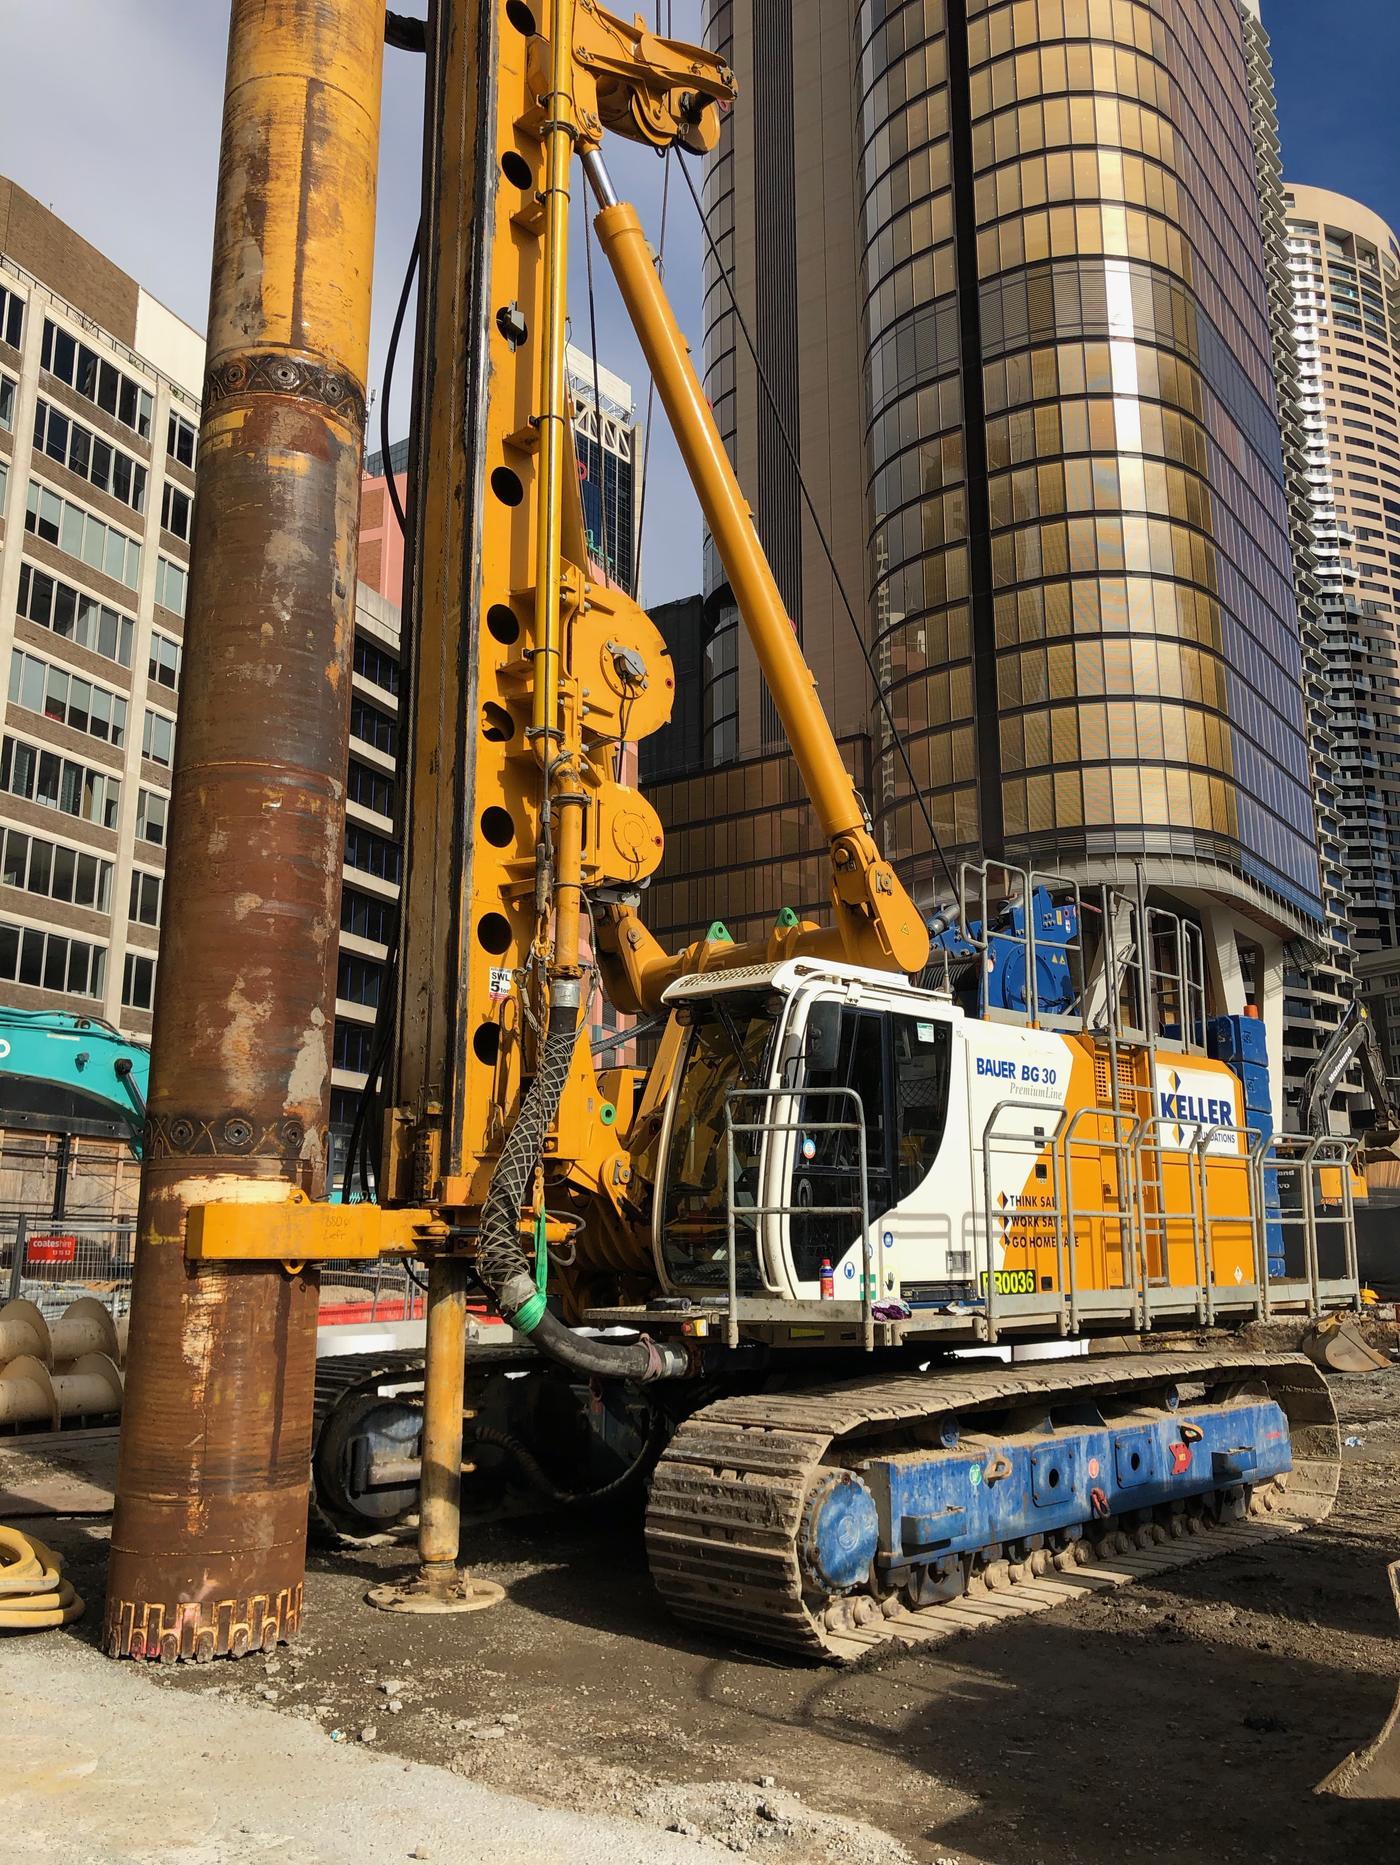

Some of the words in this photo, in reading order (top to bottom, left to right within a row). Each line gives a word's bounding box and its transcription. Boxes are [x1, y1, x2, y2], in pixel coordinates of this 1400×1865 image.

[491, 972, 510, 981] SWL
[490, 981, 500, 992] 5
[976, 1057, 1016, 1080] BAUER
[1021, 1065, 1039, 1082] BG
[1041, 1068, 1056, 1085] 30
[1328, 1046, 1353, 1084] Mainland
[1009, 1082, 1062, 1100] PremiumLine
[1160, 1092, 1233, 1127] KELLER
[1010, 1195, 1037, 1208] THINK
[1011, 1216, 1039, 1228] WORK
[1012, 1236, 1027, 1248] GO
[1029, 1236, 1056, 1249] HOME
[1060, 1236, 1079, 1248] AE
